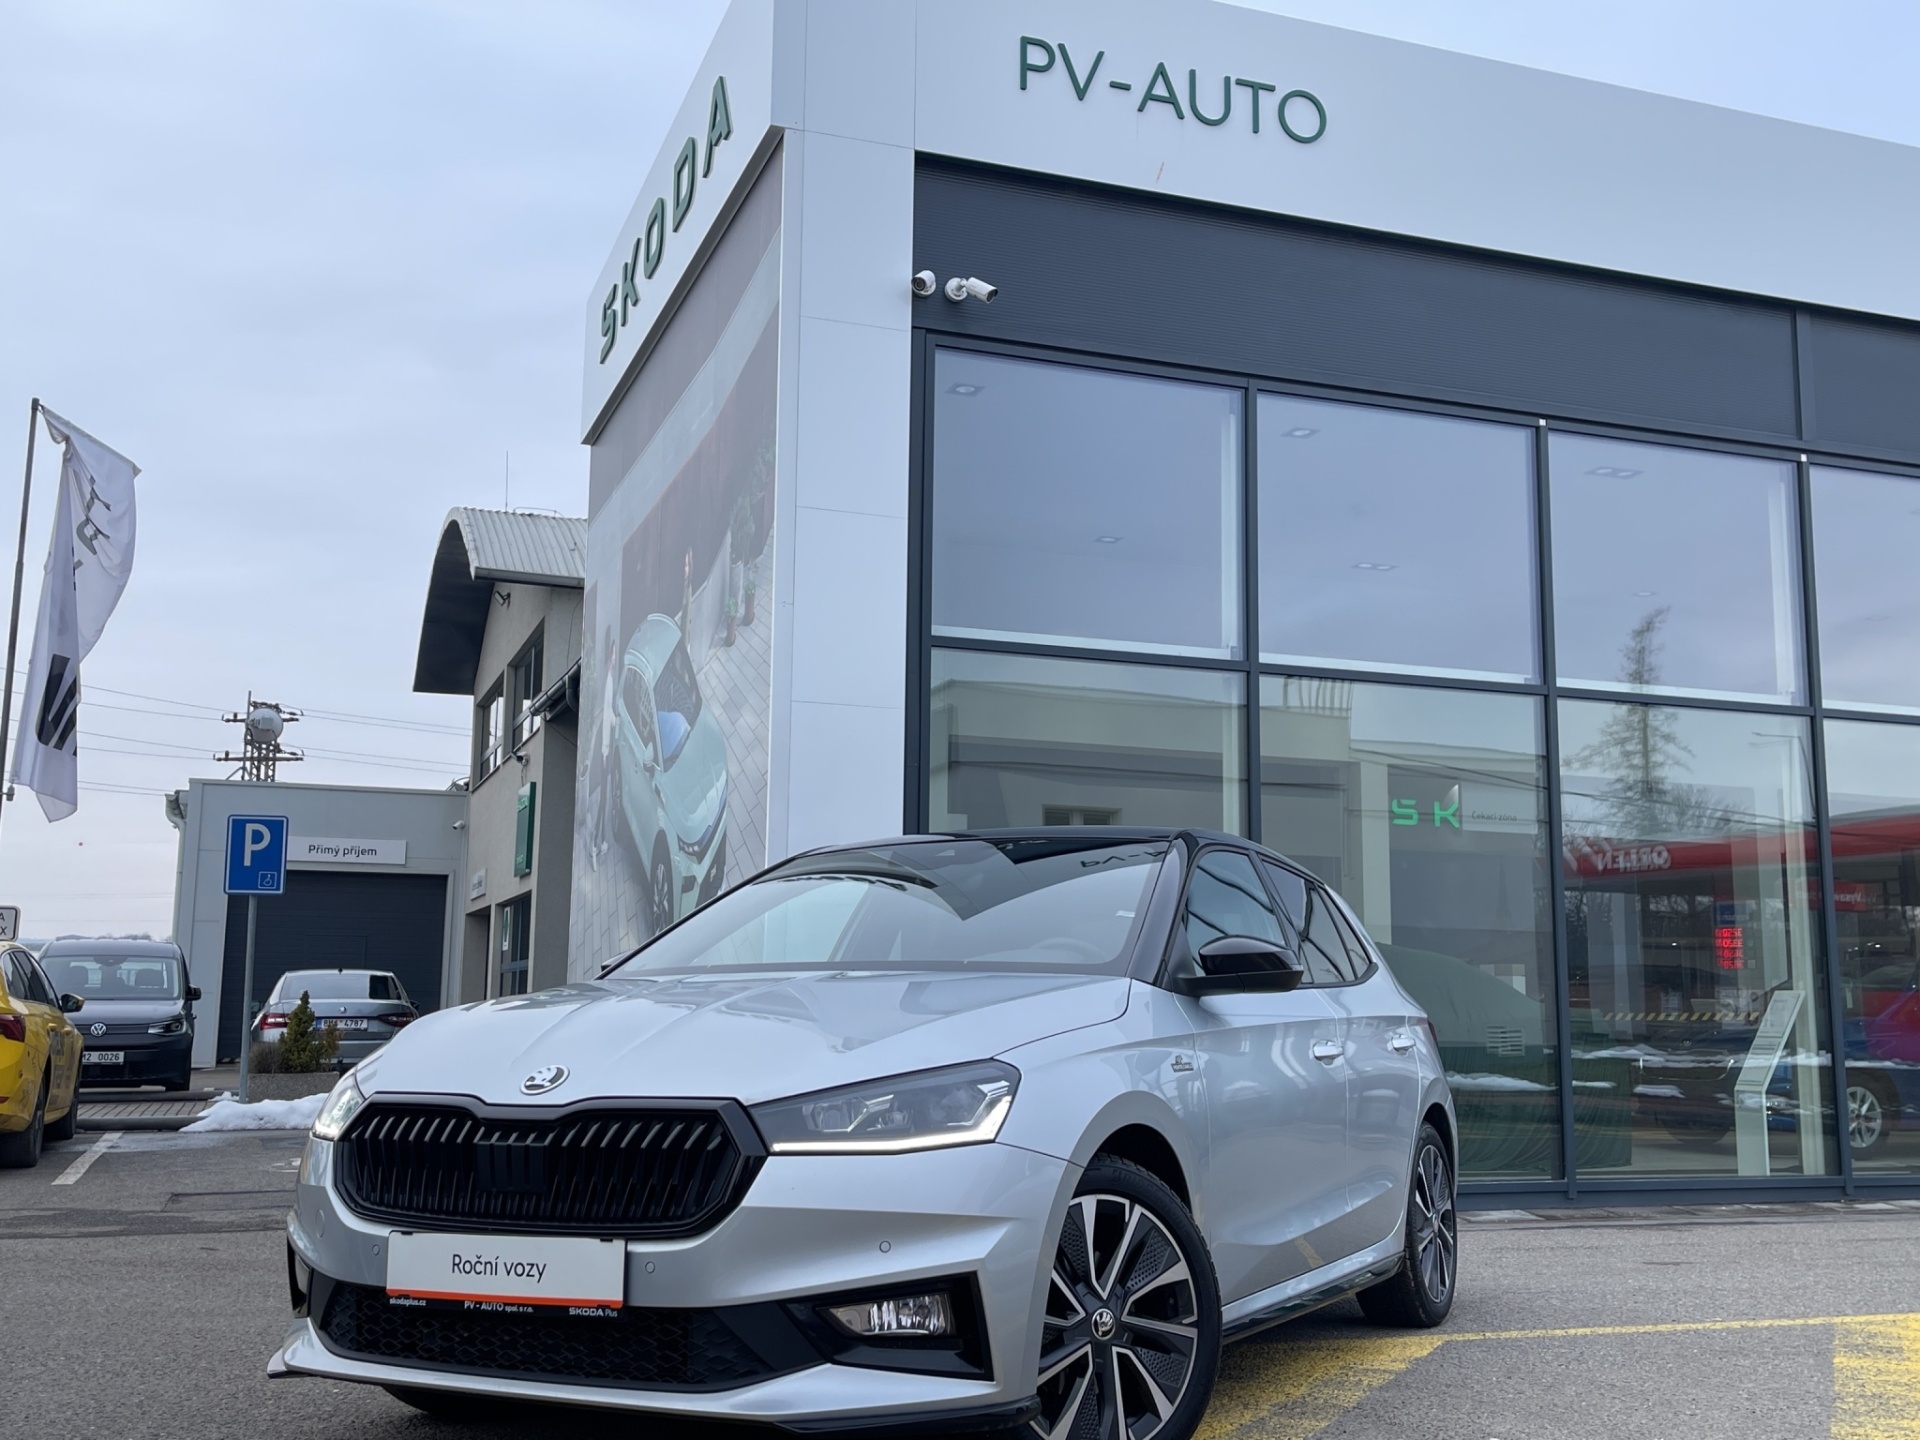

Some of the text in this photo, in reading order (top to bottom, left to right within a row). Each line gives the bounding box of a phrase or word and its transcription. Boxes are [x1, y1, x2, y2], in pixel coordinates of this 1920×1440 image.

[1020, 35, 1327, 144] PV-AUTO
[243, 822, 271, 867] P
[308, 844, 377, 858] Přímý příjem
[98, 1052, 120, 1061] 0026
[452, 1253, 547, 1284] Roční vozy
[480, 1301, 504, 1311] AUTO
[568, 1307, 618, 1317] SKODA Plus
